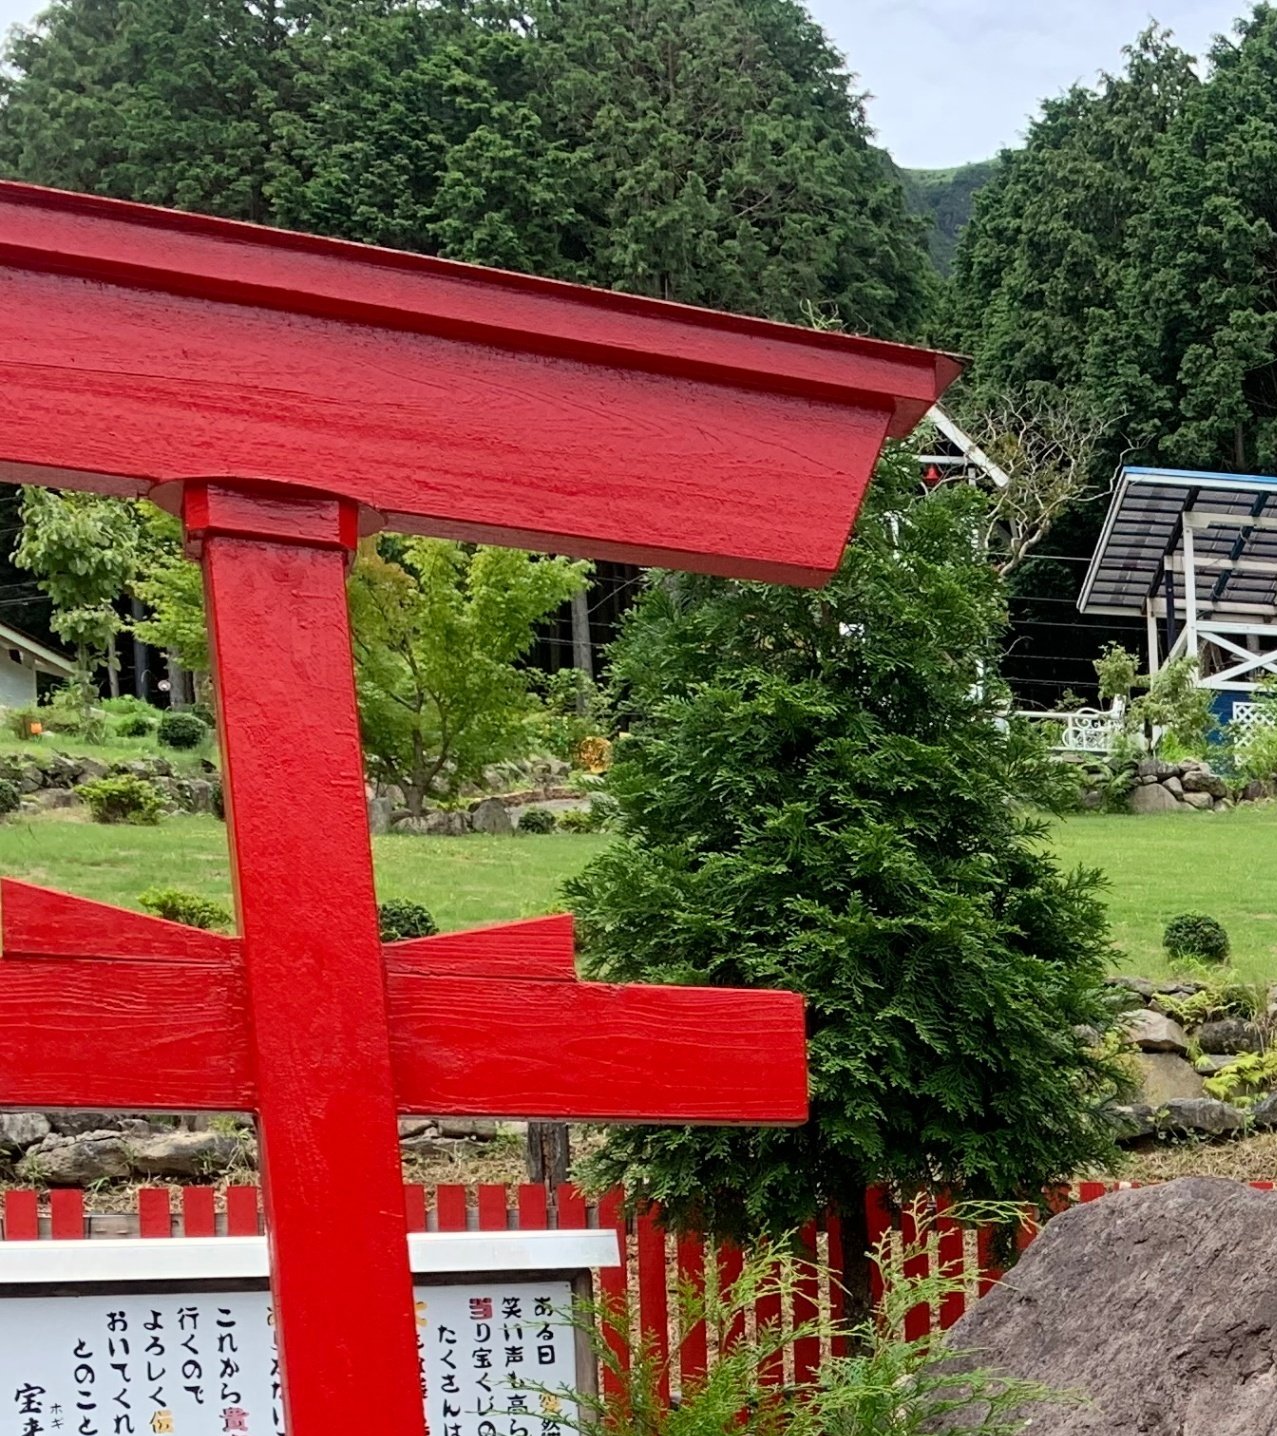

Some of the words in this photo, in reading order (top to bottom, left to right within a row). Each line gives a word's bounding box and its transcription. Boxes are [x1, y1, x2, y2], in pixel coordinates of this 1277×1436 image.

[106, 1311, 135, 1434] おいてくれ
[177, 1306, 204, 1404] 行くので
[534, 1297, 556, 1365] ある日
[51, 1403, 64, 1429] ホギ
